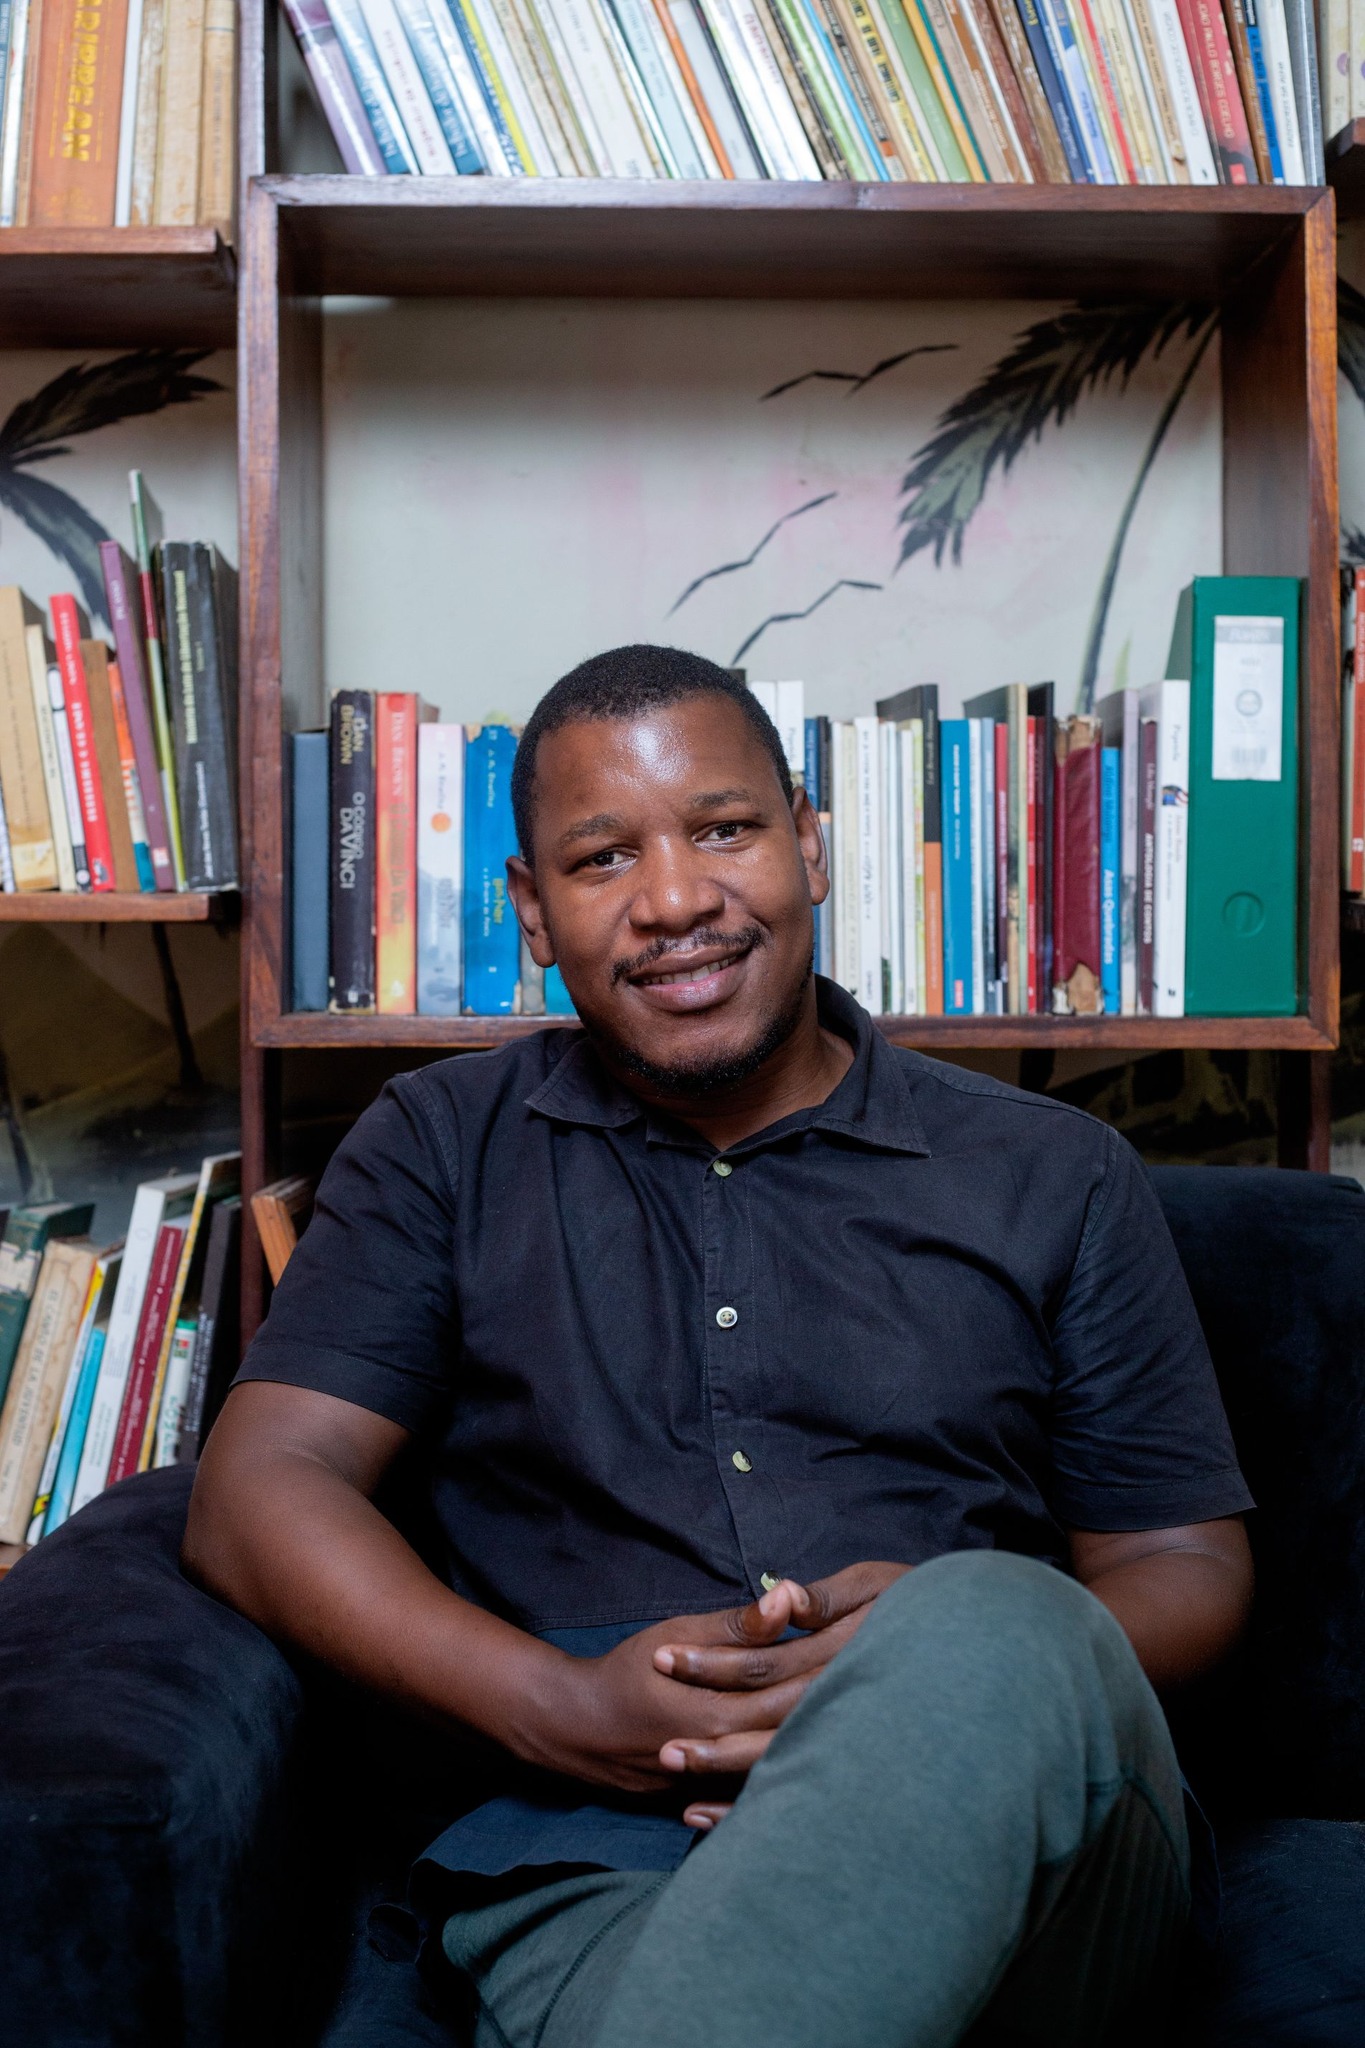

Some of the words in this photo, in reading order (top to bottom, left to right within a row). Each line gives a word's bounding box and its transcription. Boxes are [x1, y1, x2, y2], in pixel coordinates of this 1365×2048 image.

[1200, 26, 1219, 59] PAULO
[64, 0, 102, 161] RIBBEAN
[1206, 57, 1227, 99] BORGES
[1214, 97, 1236, 140] COELHO
[340, 704, 353, 764] BROWN
[391, 711, 405, 741] DAN
[391, 746, 405, 796] BROWN
[352, 791, 365, 805] O
[1143, 832, 1153, 888] ANTOLOGIA
[1104, 869, 1113, 898] Asas
[1143, 889, 1152, 902] DE
[1102, 899, 1114, 964] Quebradas
[1141, 904, 1152, 944] CONTOS
[26, 1366, 40, 1383] LA
[31, 1347, 44, 1363] DE
[10, 1385, 35, 1447] JUVENTUD
